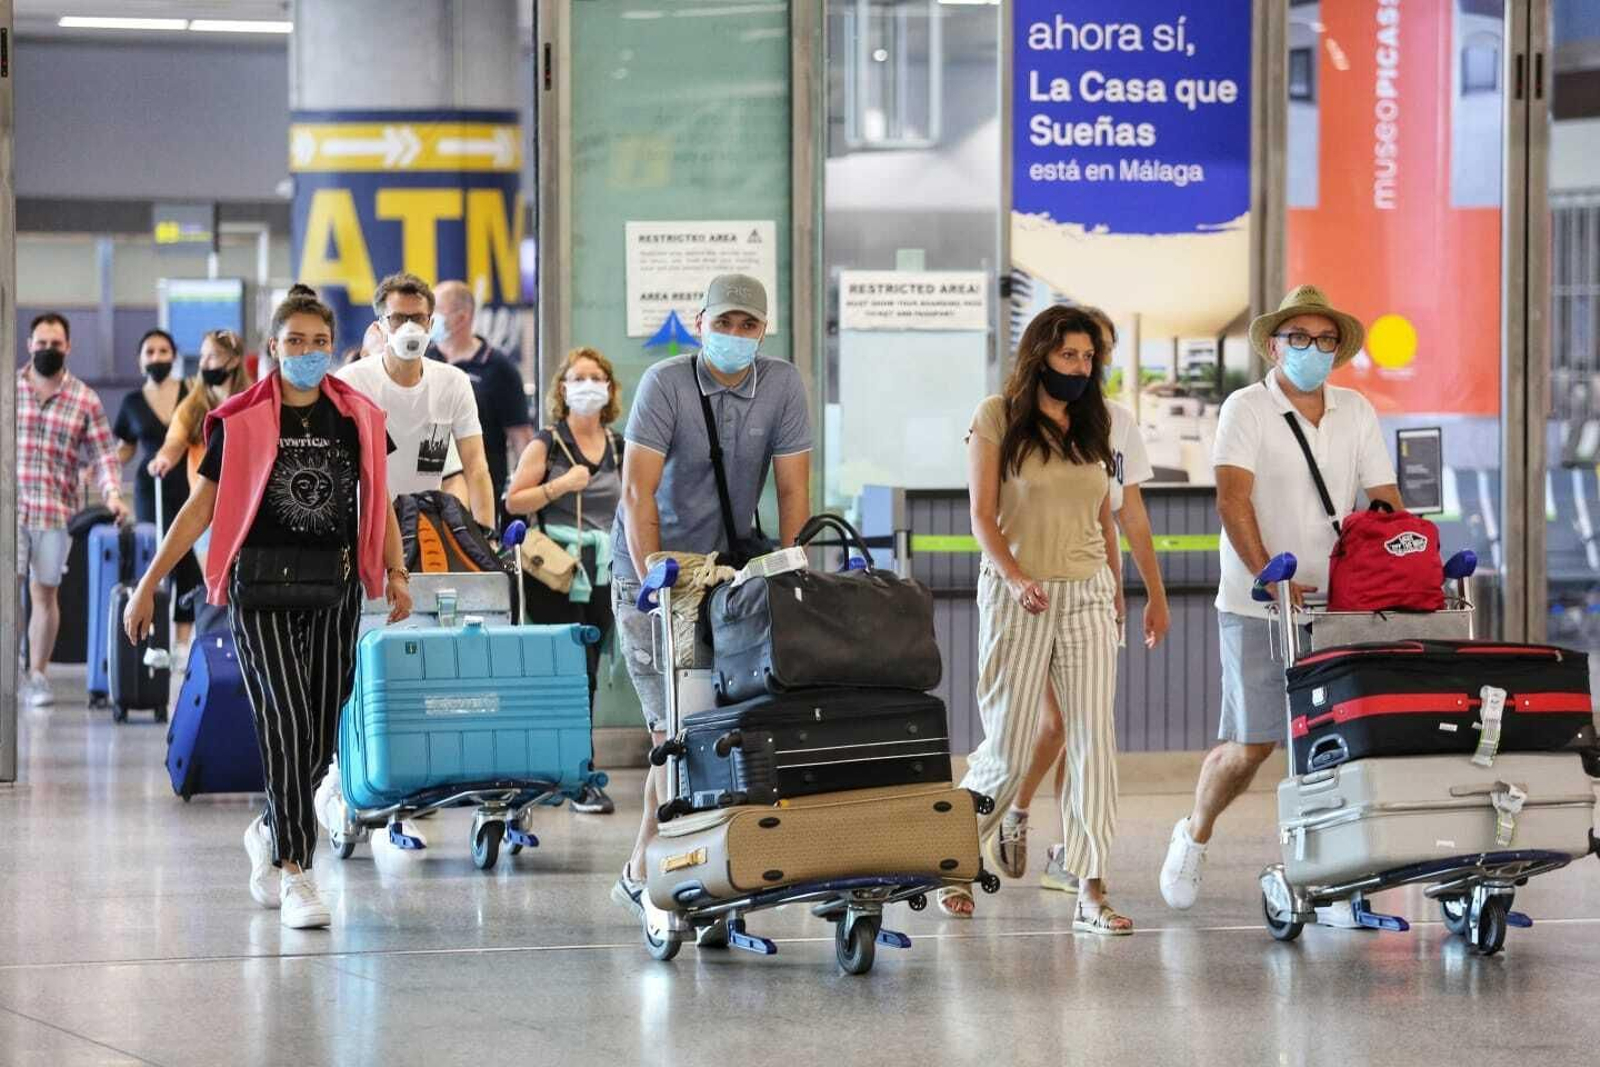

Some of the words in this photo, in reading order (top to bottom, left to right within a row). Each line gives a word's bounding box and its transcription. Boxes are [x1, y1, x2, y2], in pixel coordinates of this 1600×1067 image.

[1028, 14, 1144, 51] ahora
[1152, 15, 1195, 57] sí,
[1029, 69, 1072, 102] La
[1078, 70, 1168, 103] Casa
[1174, 79, 1239, 111] que
[1029, 113, 1156, 147] Sueñas
[1029, 158, 1081, 182] está
[1085, 162, 1115, 182] en
[1118, 158, 1205, 187] Málaga
[299, 188, 524, 305] ATM
[638, 233, 706, 244] RESTRICTED
[709, 233, 738, 244] AREA
[640, 291, 669, 301] AREA
[848, 283, 936, 295] RESTRICTED
